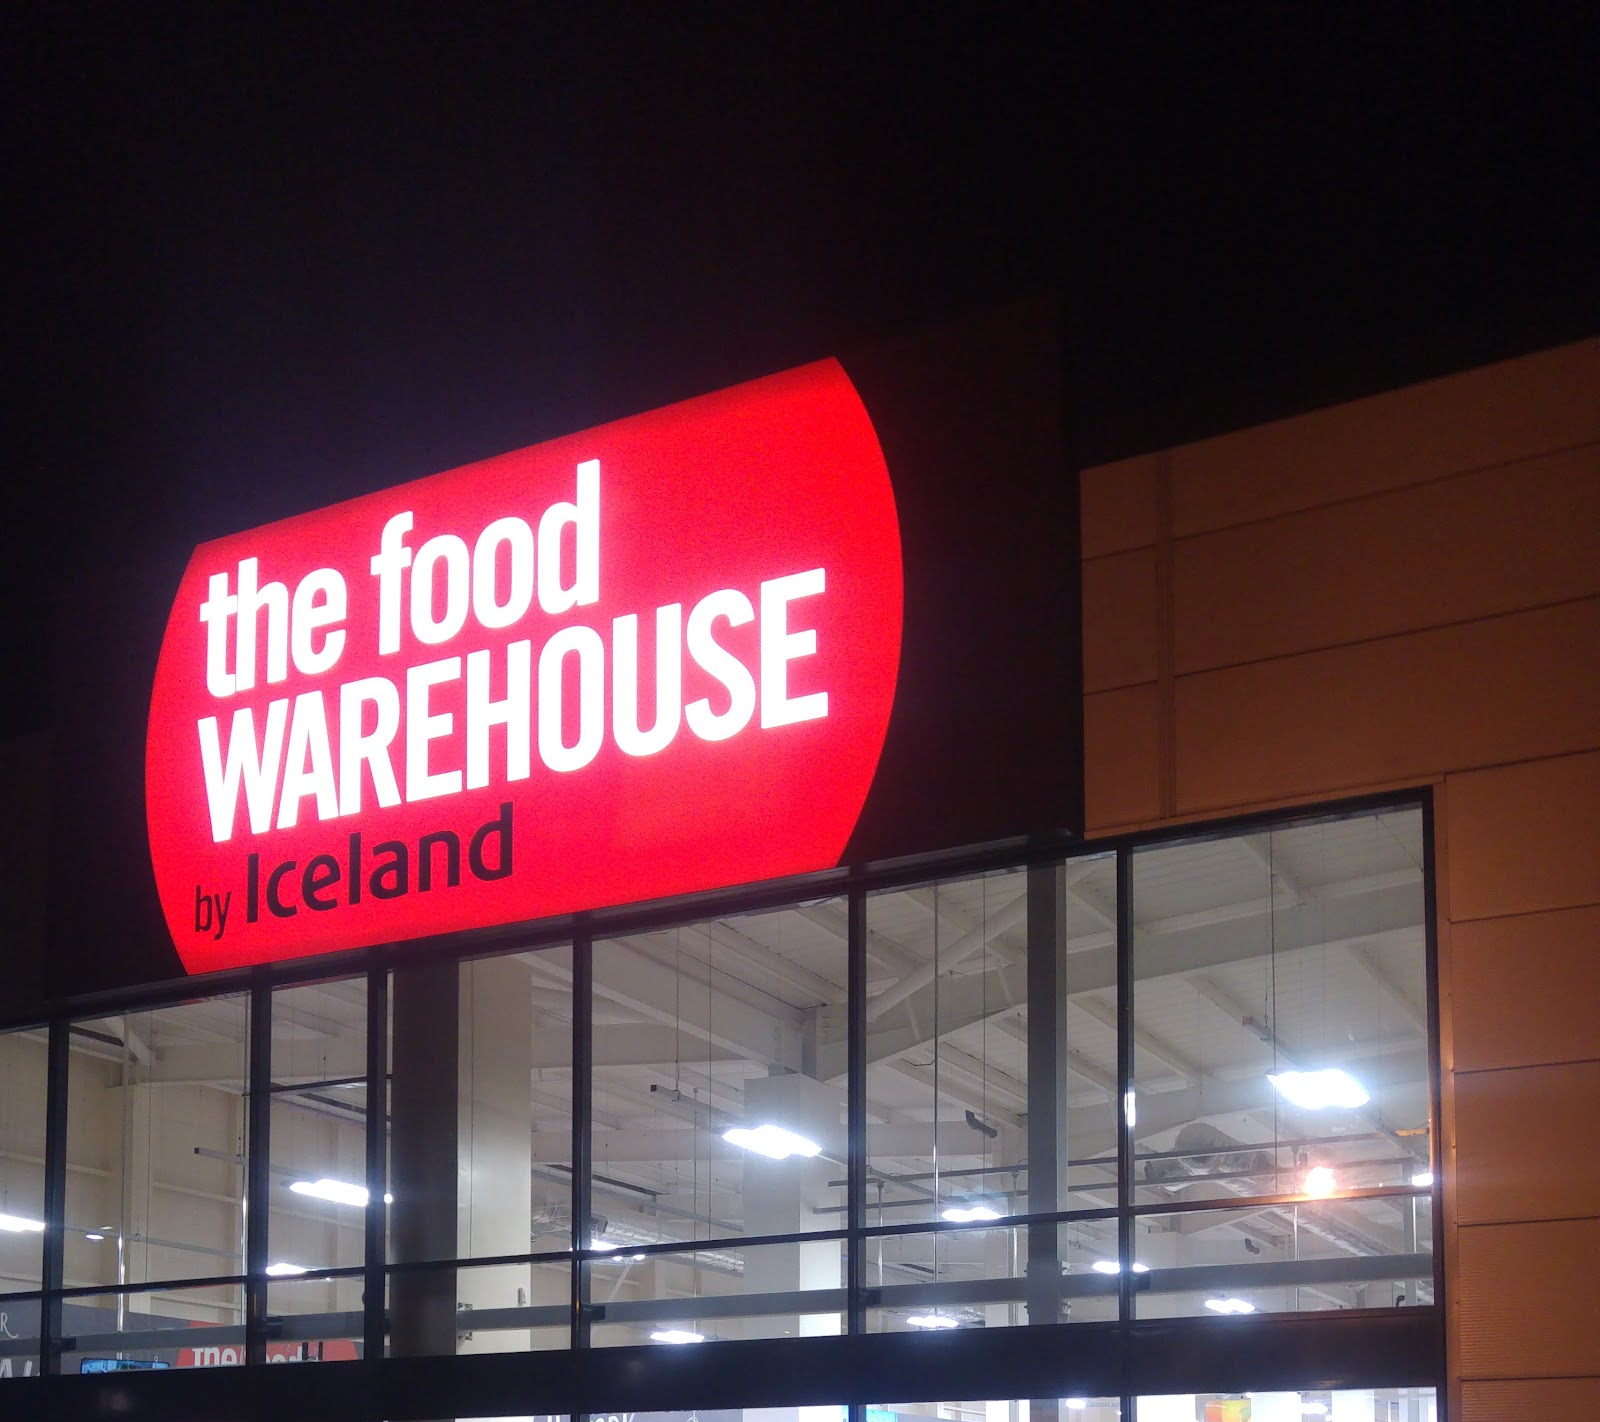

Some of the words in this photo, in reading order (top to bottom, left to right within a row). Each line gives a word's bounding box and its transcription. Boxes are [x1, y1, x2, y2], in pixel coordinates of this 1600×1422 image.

[199, 557, 347, 699] the
[371, 458, 600, 657] food
[197, 567, 830, 843] WAREHOUSE
[193, 884, 231, 941] by
[245, 802, 514, 924] Iceland
